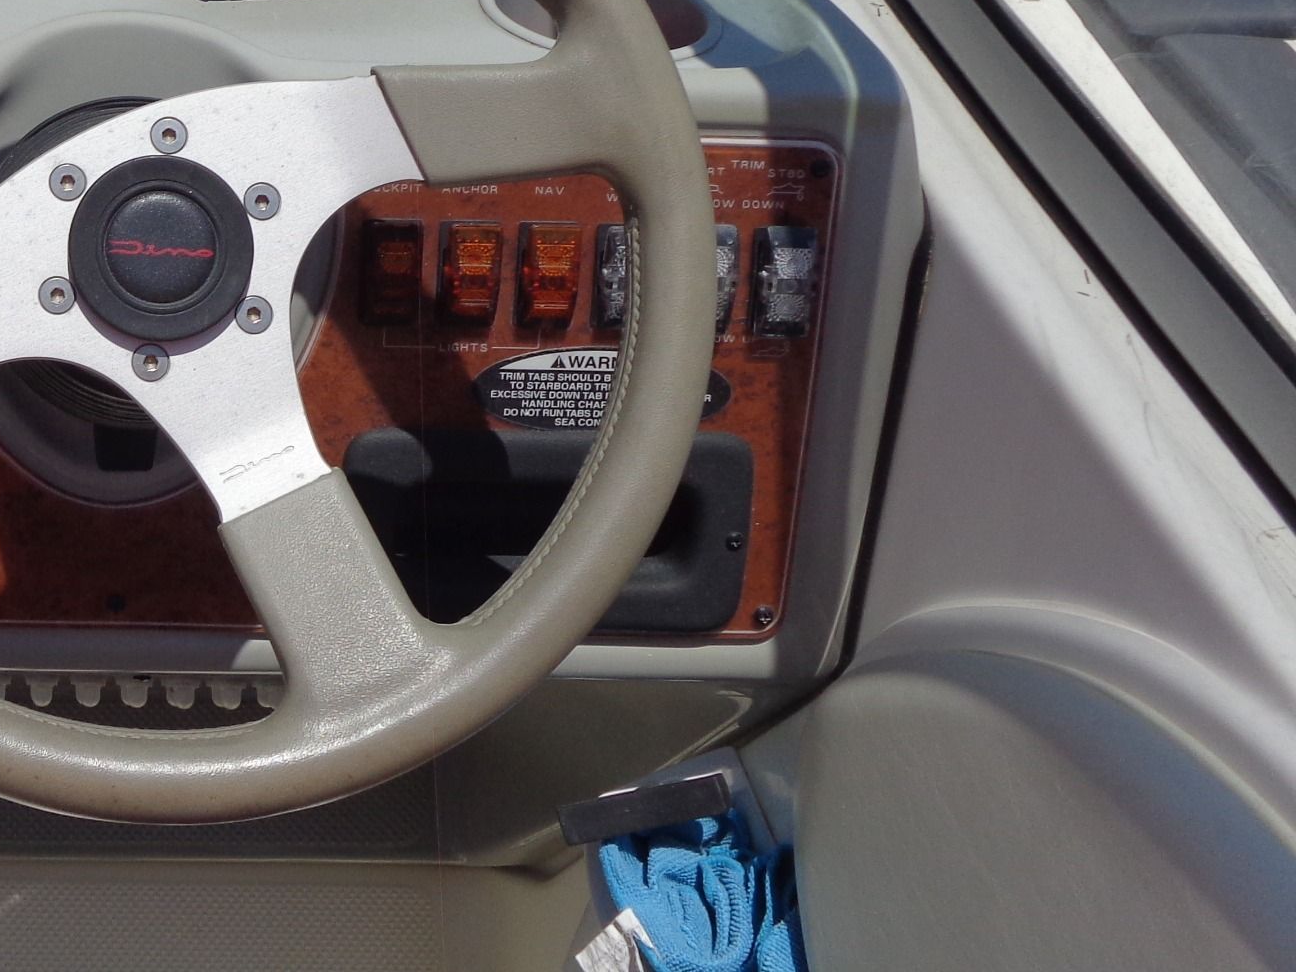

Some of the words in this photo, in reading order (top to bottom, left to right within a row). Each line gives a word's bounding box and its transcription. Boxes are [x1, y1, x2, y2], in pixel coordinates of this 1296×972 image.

[731, 159, 766, 170] TRIM
[767, 168, 805, 179] STBD
[442, 184, 498, 195] ANCHOR
[535, 186, 565, 195] NAV
[713, 199, 735, 208] OW
[742, 199, 784, 210] DOWN
[439, 342, 488, 353] LIGHTS
[499, 372, 525, 381] TRIM
[527, 372, 555, 381] TABS
[557, 373, 601, 382] SHOULD
[509, 381, 524, 390] TO
[526, 381, 592, 391] STARBOARD
[490, 390, 547, 399] EXCESSIVE
[548, 390, 580, 399] DOWN
[583, 391, 603, 399] TAB
[521, 399, 575, 408] HANDLING
[503, 408, 519, 416] DO
[520, 408, 542, 417] NOT
[542, 409, 564, 417] RUN
[565, 409, 591, 418] TABS
[554, 417, 575, 426] SEA
